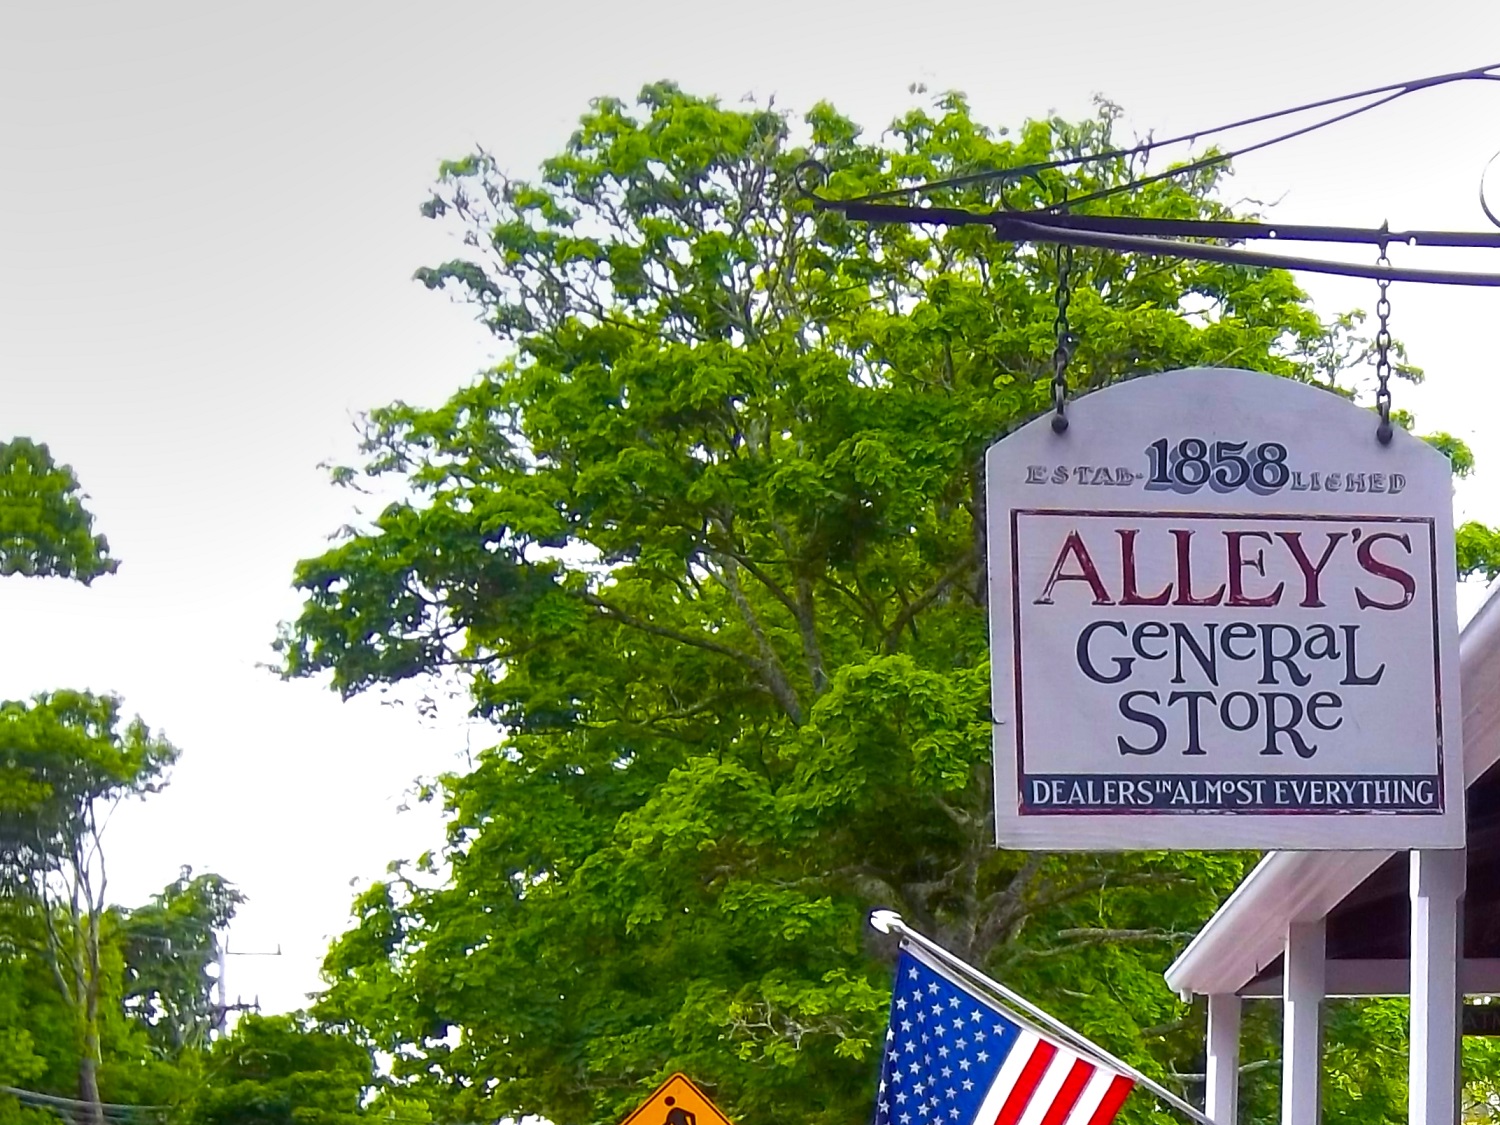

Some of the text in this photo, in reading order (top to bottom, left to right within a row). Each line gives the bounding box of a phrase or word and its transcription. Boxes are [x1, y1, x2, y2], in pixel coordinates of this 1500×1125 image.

[1145, 437, 1291, 495] 1858
[1033, 528, 1418, 611] ALLEY'S
[1031, 779, 1154, 807] DEALERS
[1155, 779, 1172, 793] IN
[1275, 780, 1435, 806] EVERYTHING
